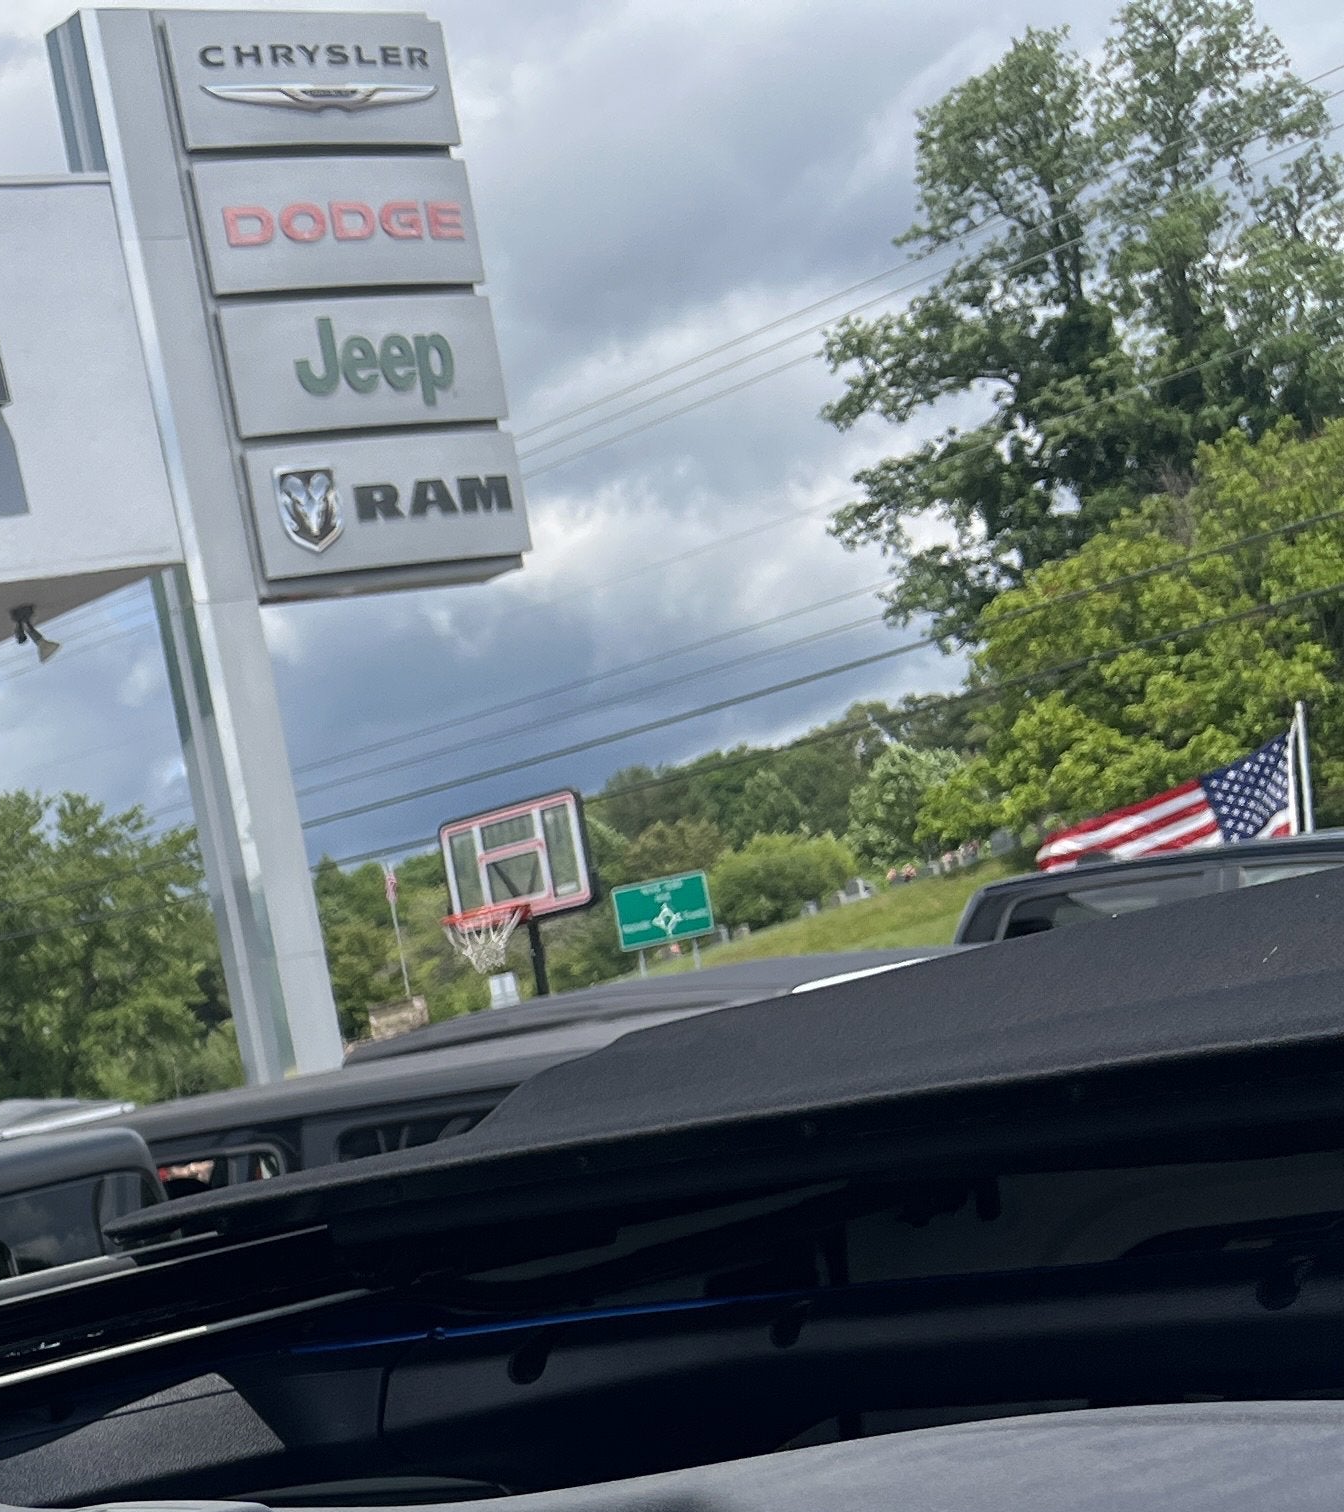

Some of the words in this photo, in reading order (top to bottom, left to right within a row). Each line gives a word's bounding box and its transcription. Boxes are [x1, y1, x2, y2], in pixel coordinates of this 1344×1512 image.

[199, 44, 430, 68] CHRYSLER
[222, 201, 466, 247] DODGE
[293, 316, 455, 406] Jeep
[353, 476, 513, 522] RAM
